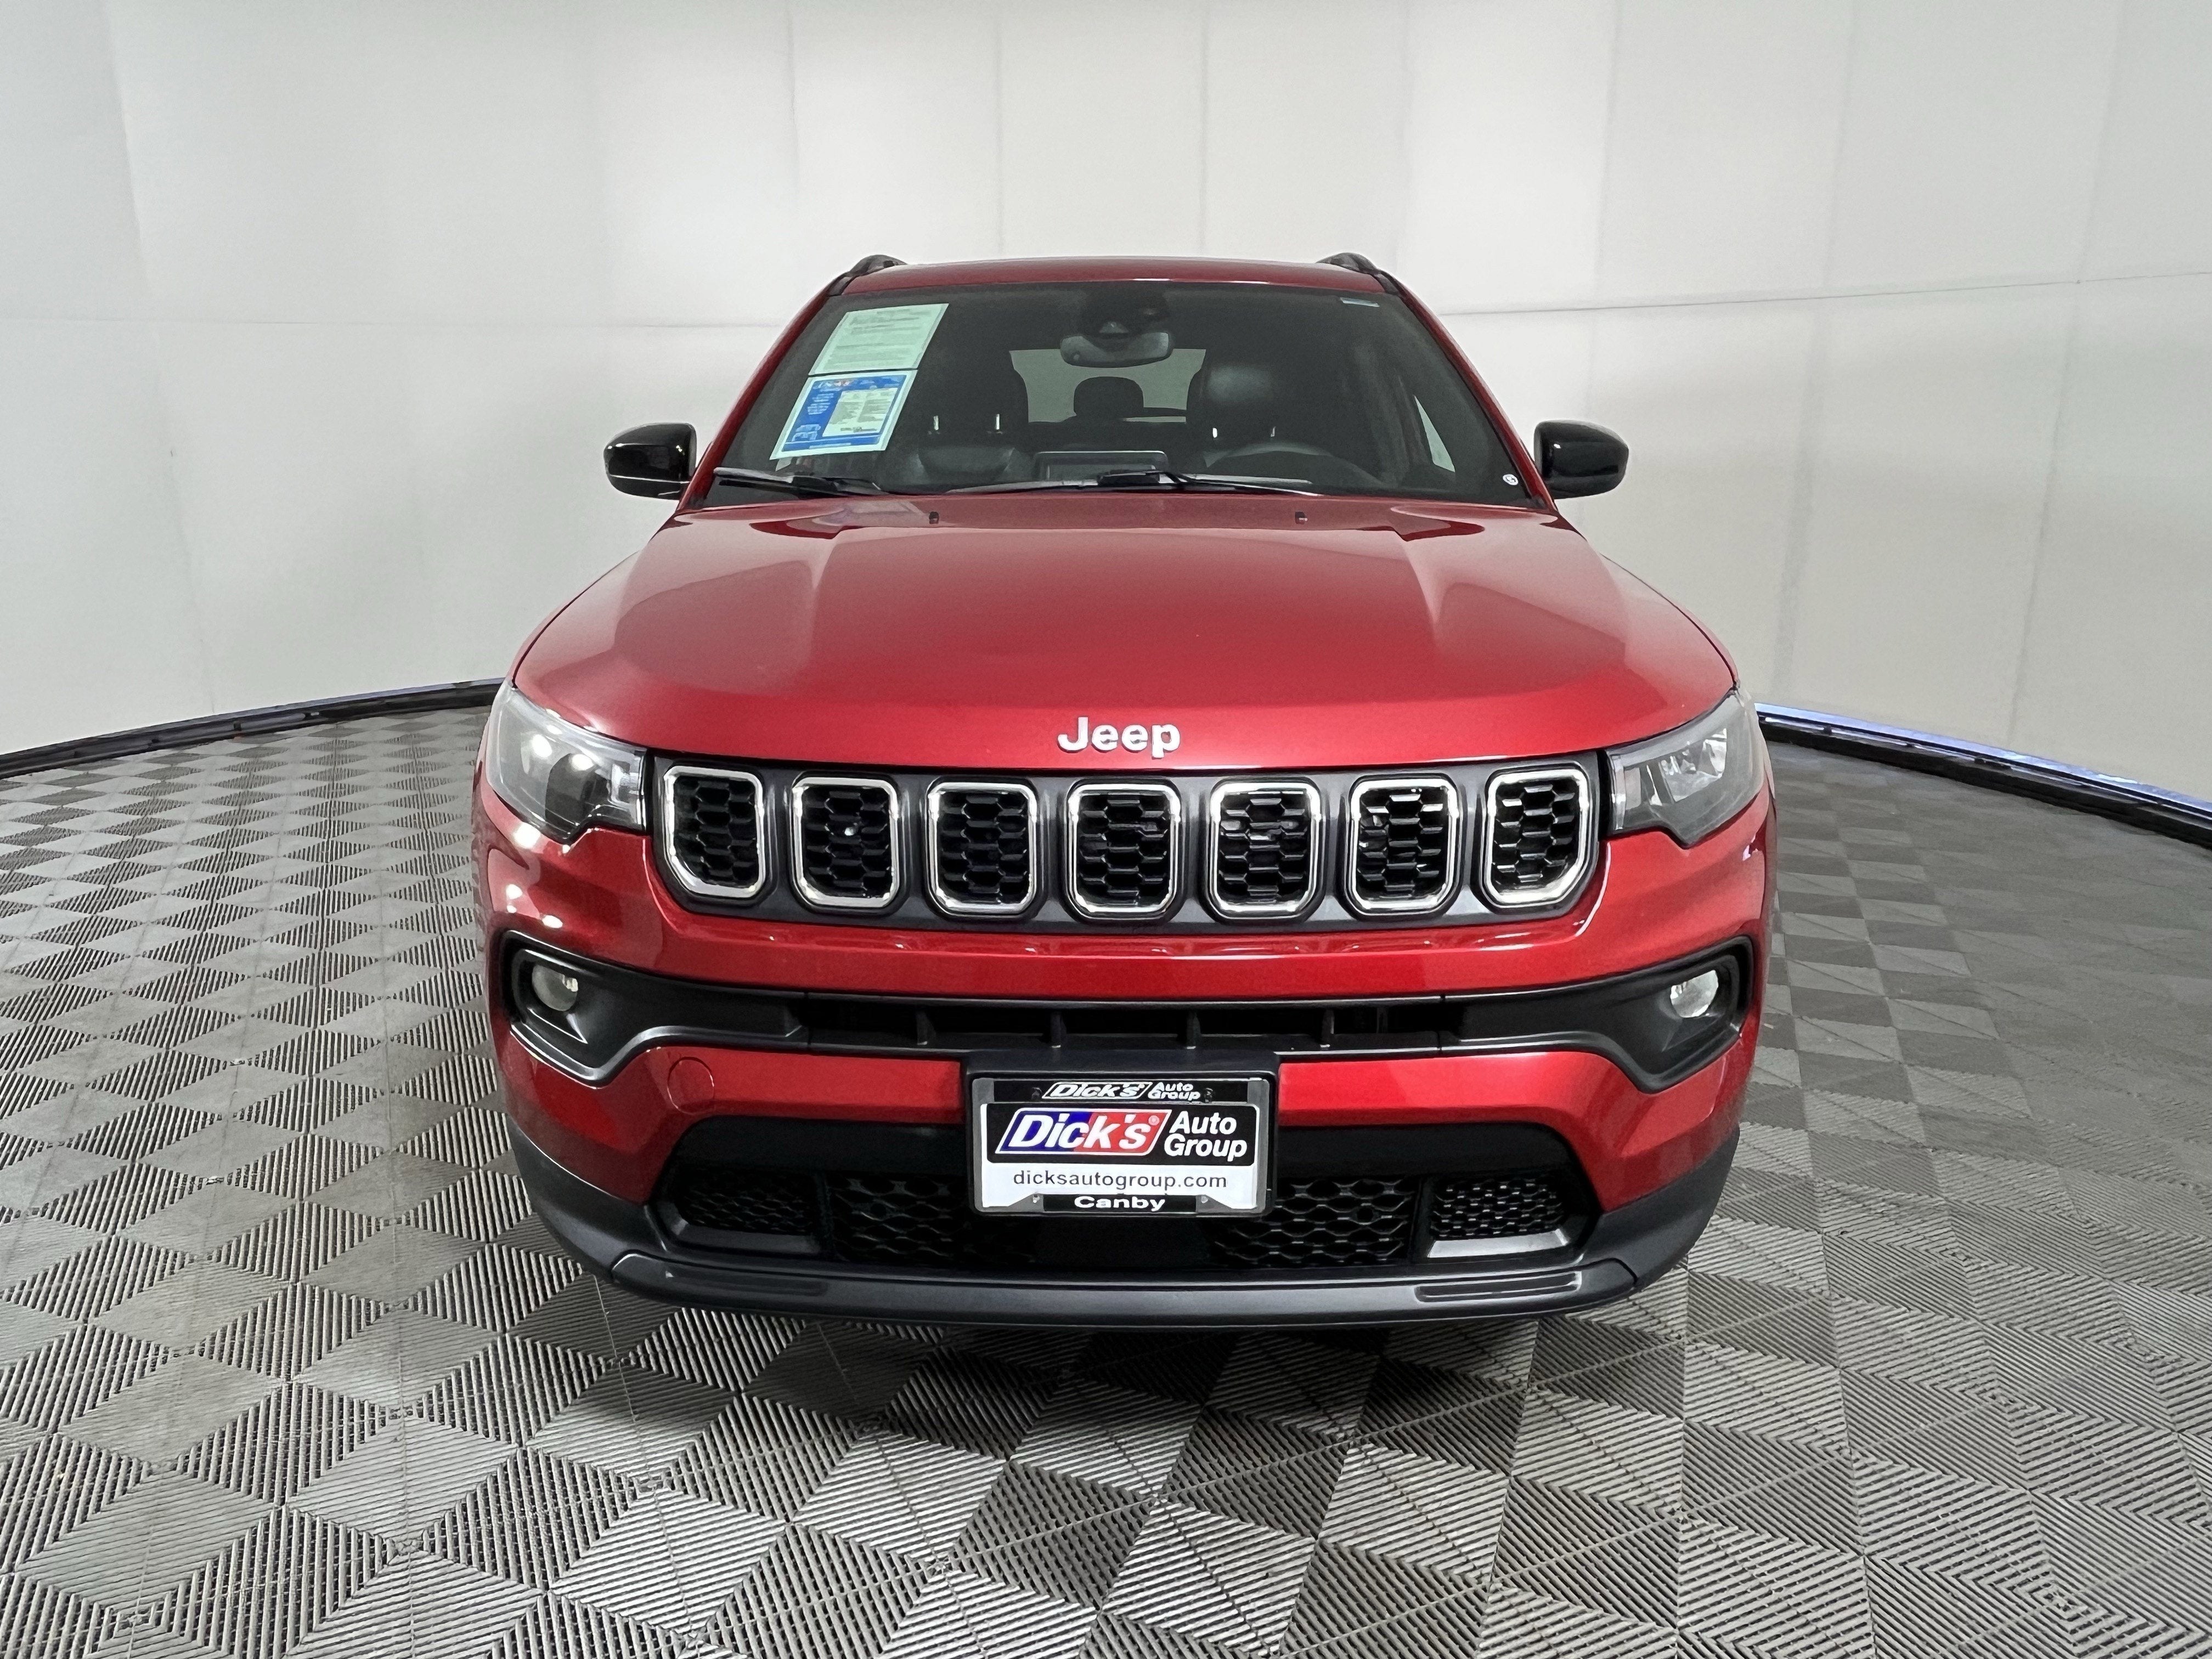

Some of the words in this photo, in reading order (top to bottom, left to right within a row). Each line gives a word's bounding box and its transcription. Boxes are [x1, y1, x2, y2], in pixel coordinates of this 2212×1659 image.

[1057, 716, 1180, 759] Jeep
[1049, 1083, 1141, 1097] Dick's
[1148, 1091, 1201, 1101] Group
[1154, 1082, 1194, 1092] Auto
[1008, 1113, 1152, 1150] Dick's
[1169, 1110, 1237, 1135] Auto
[1164, 1133, 1248, 1161] Group
[1013, 1170, 1228, 1190] dicksautogroup.com
[1074, 1195, 1166, 1212] Canby
